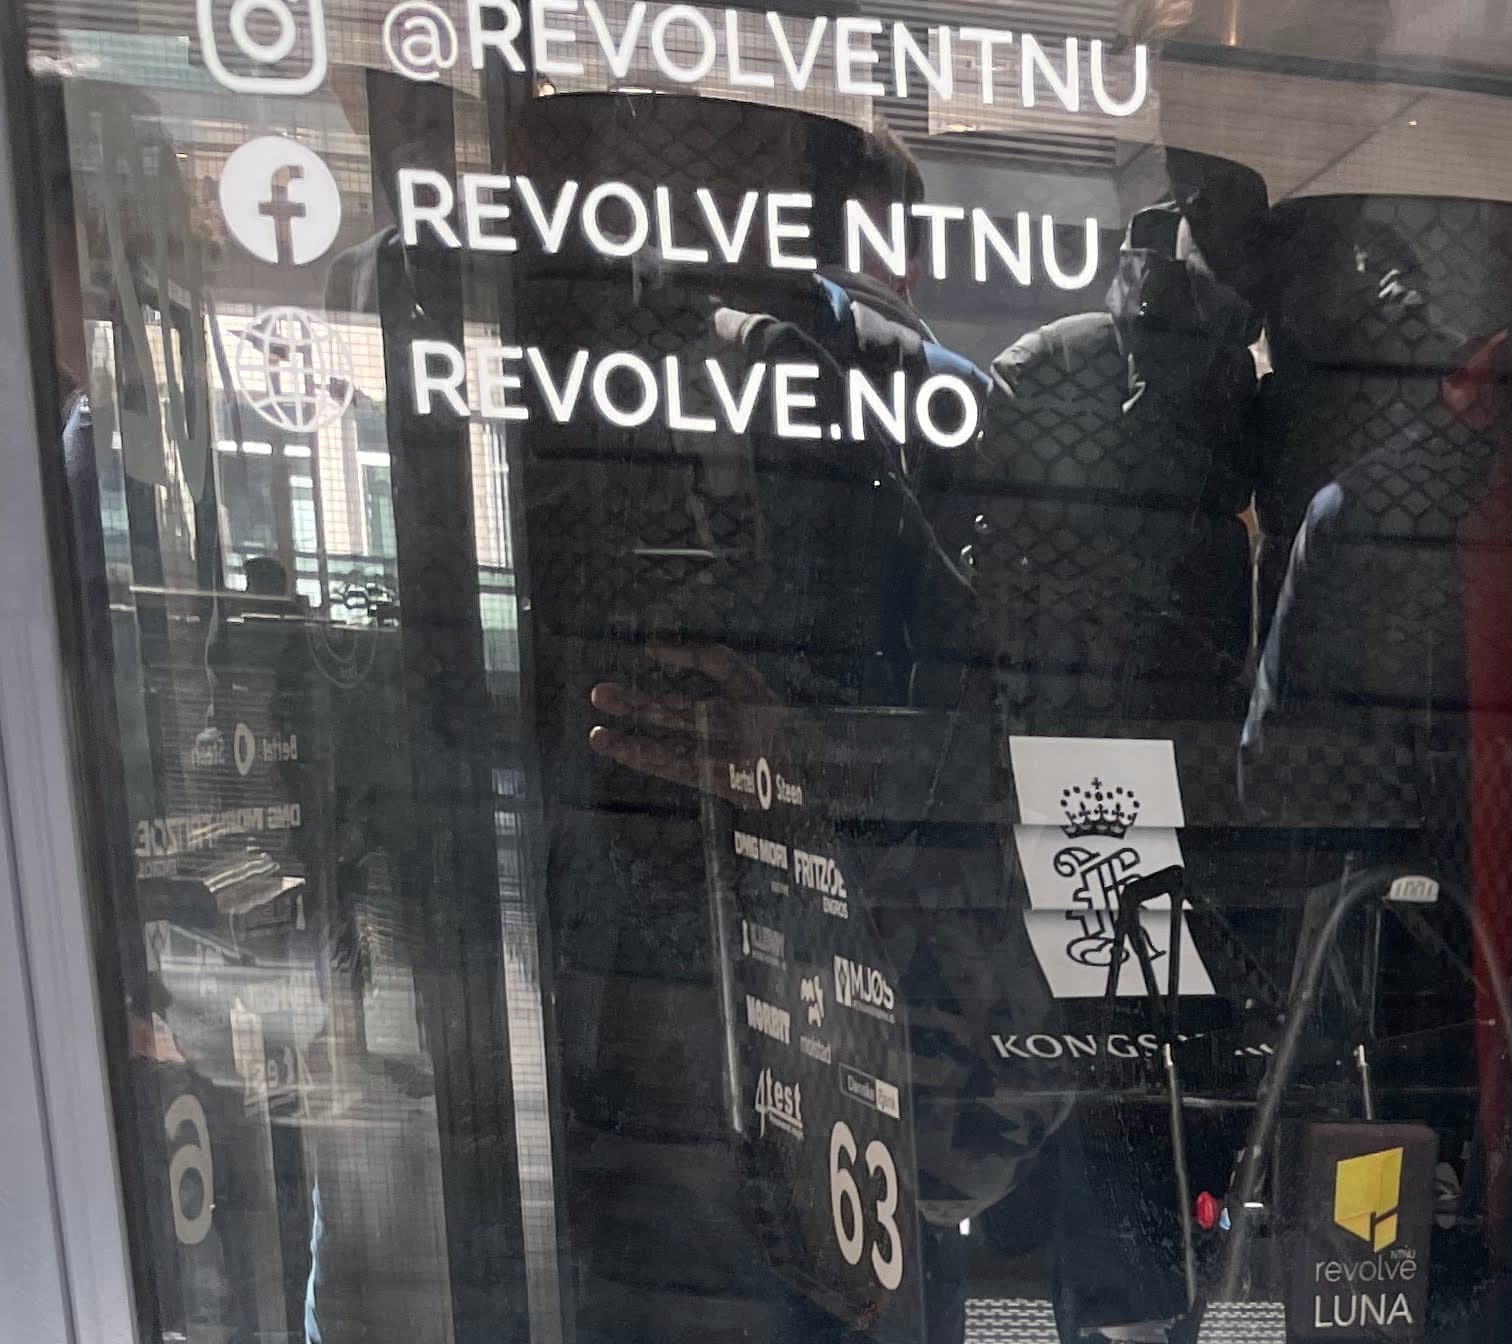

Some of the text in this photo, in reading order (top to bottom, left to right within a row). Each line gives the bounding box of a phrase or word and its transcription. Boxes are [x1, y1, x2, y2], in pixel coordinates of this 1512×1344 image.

[384, 0, 1148, 118] @REVOLVENTNU
[396, 168, 1100, 291] REVOLVE NTNU
[411, 339, 981, 447] REVOLVE.NO
[830, 1121, 904, 1290] 63
[1315, 1255, 1417, 1282] revolve
[1315, 1293, 1413, 1328] LUNA
